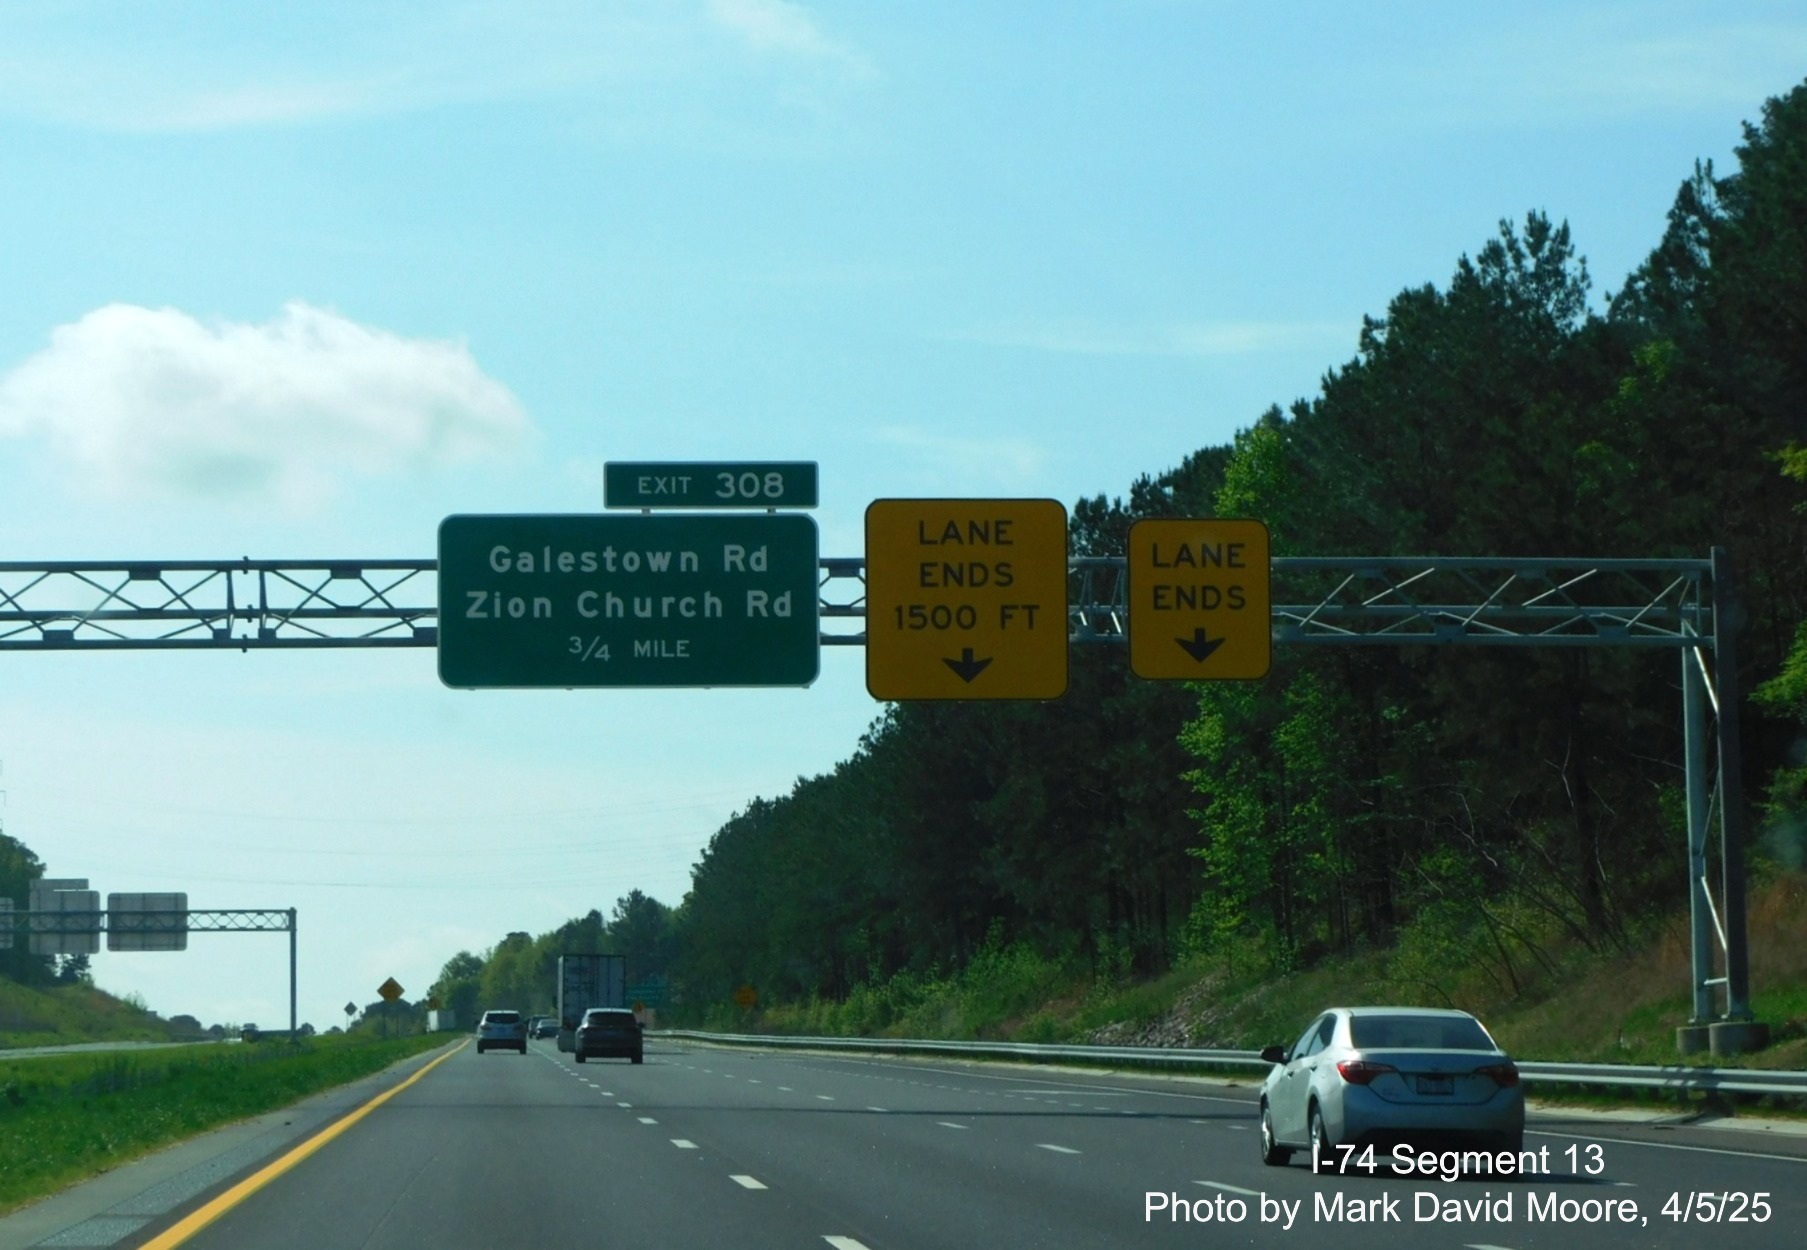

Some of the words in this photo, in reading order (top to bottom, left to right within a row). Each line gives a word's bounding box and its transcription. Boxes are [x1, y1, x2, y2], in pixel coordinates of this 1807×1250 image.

[638, 476, 692, 494] EXIT
[715, 472, 785, 498] 308
[918, 519, 1014, 546] LANE
[489, 545, 699, 573] Galestown
[723, 544, 768, 572] Rd
[1152, 542, 1246, 569] LANE
[919, 562, 1014, 588] ENDS
[465, 590, 553, 619] Zion
[577, 590, 724, 619] Church
[746, 590, 793, 618] Rd
[1152, 585, 1247, 611] ENDS
[894, 604, 977, 631] 1500
[999, 604, 1040, 630] FT
[633, 639, 691, 658] MILE
